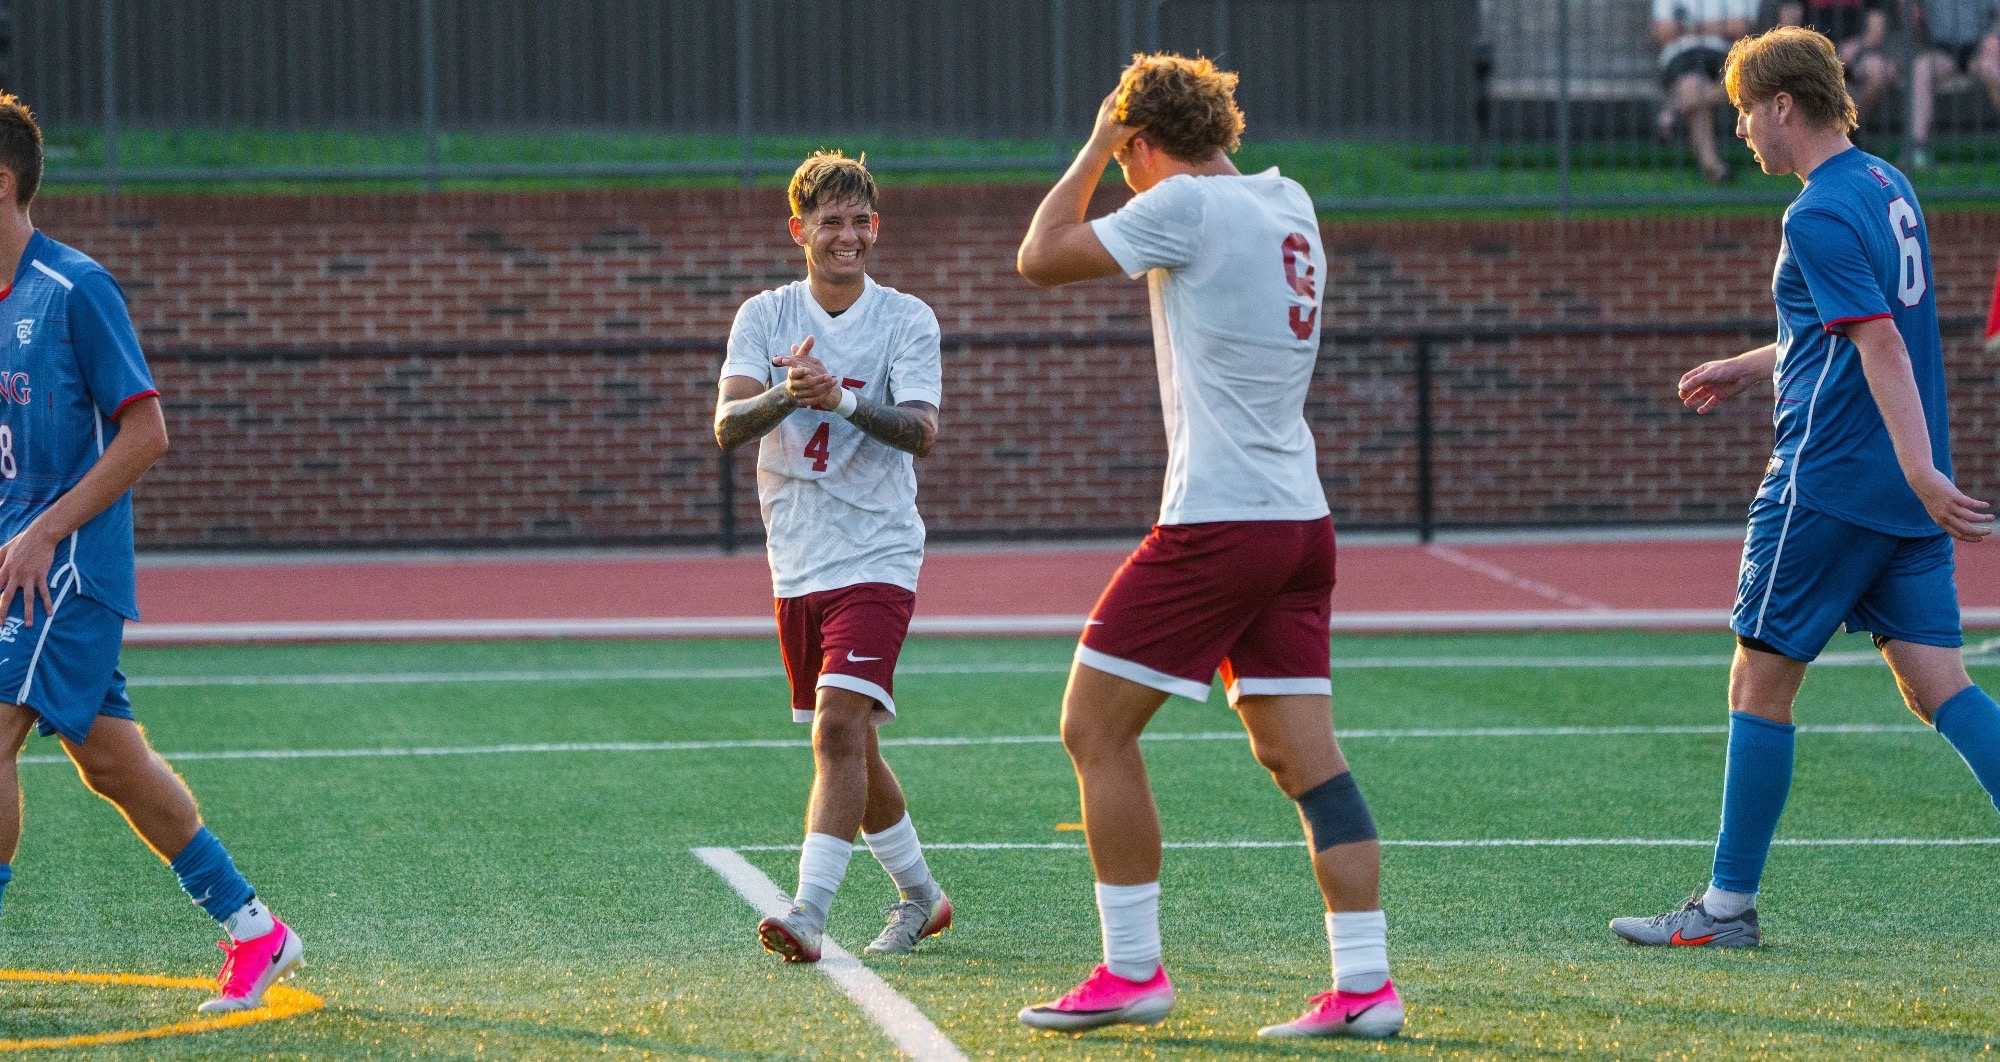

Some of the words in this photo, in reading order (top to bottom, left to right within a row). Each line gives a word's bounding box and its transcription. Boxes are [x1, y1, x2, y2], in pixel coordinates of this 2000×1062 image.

[1281, 232, 1318, 341] 9
[1888, 195, 1927, 308] 6
[803, 421, 830, 473] 4
